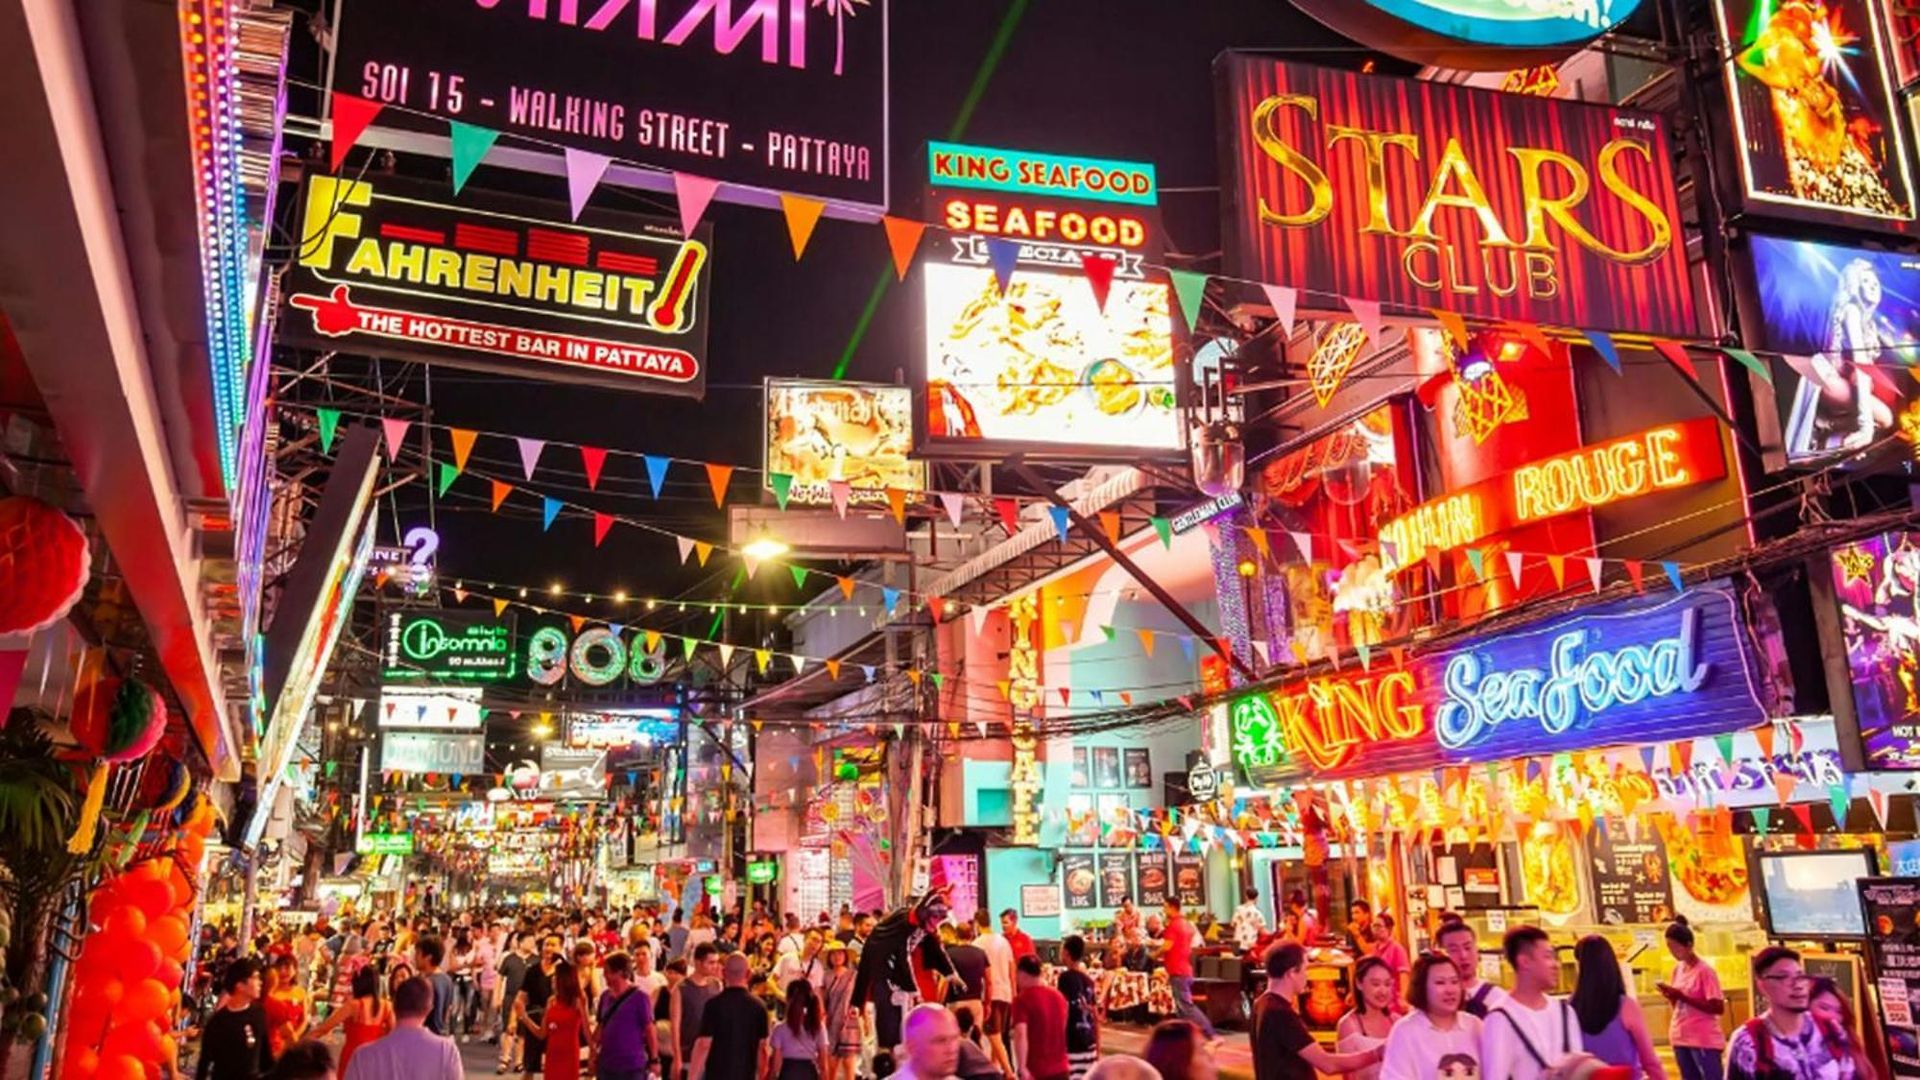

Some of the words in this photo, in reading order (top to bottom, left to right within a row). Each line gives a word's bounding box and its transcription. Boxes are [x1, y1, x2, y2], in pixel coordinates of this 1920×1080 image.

[362, 61, 409, 102] SOI
[429, 71, 465, 113] 15
[509, 85, 625, 141] WALKING
[639, 109, 729, 159] STREET
[768, 131, 871, 181] PATTAYA
[934, 152, 1010, 181] KING
[1018, 160, 1151, 196] SEAFOOD
[1253, 93, 1672, 267] STARS
[299, 175, 656, 314] FAHRENHEIT
[945, 200, 1145, 247] SEAFOOD
[1404, 241, 1559, 299] CLUB
[357, 310, 402, 336] THE
[409, 319, 511, 349] HOTTEST
[516, 336, 560, 357] BAR
[566, 342, 590, 361] IN
[595, 347, 685, 374] PATTAYA
[1514, 429, 1687, 521] ROUGE
[527, 626, 667, 686] 808
[1436, 607, 1710, 749] Seafood
